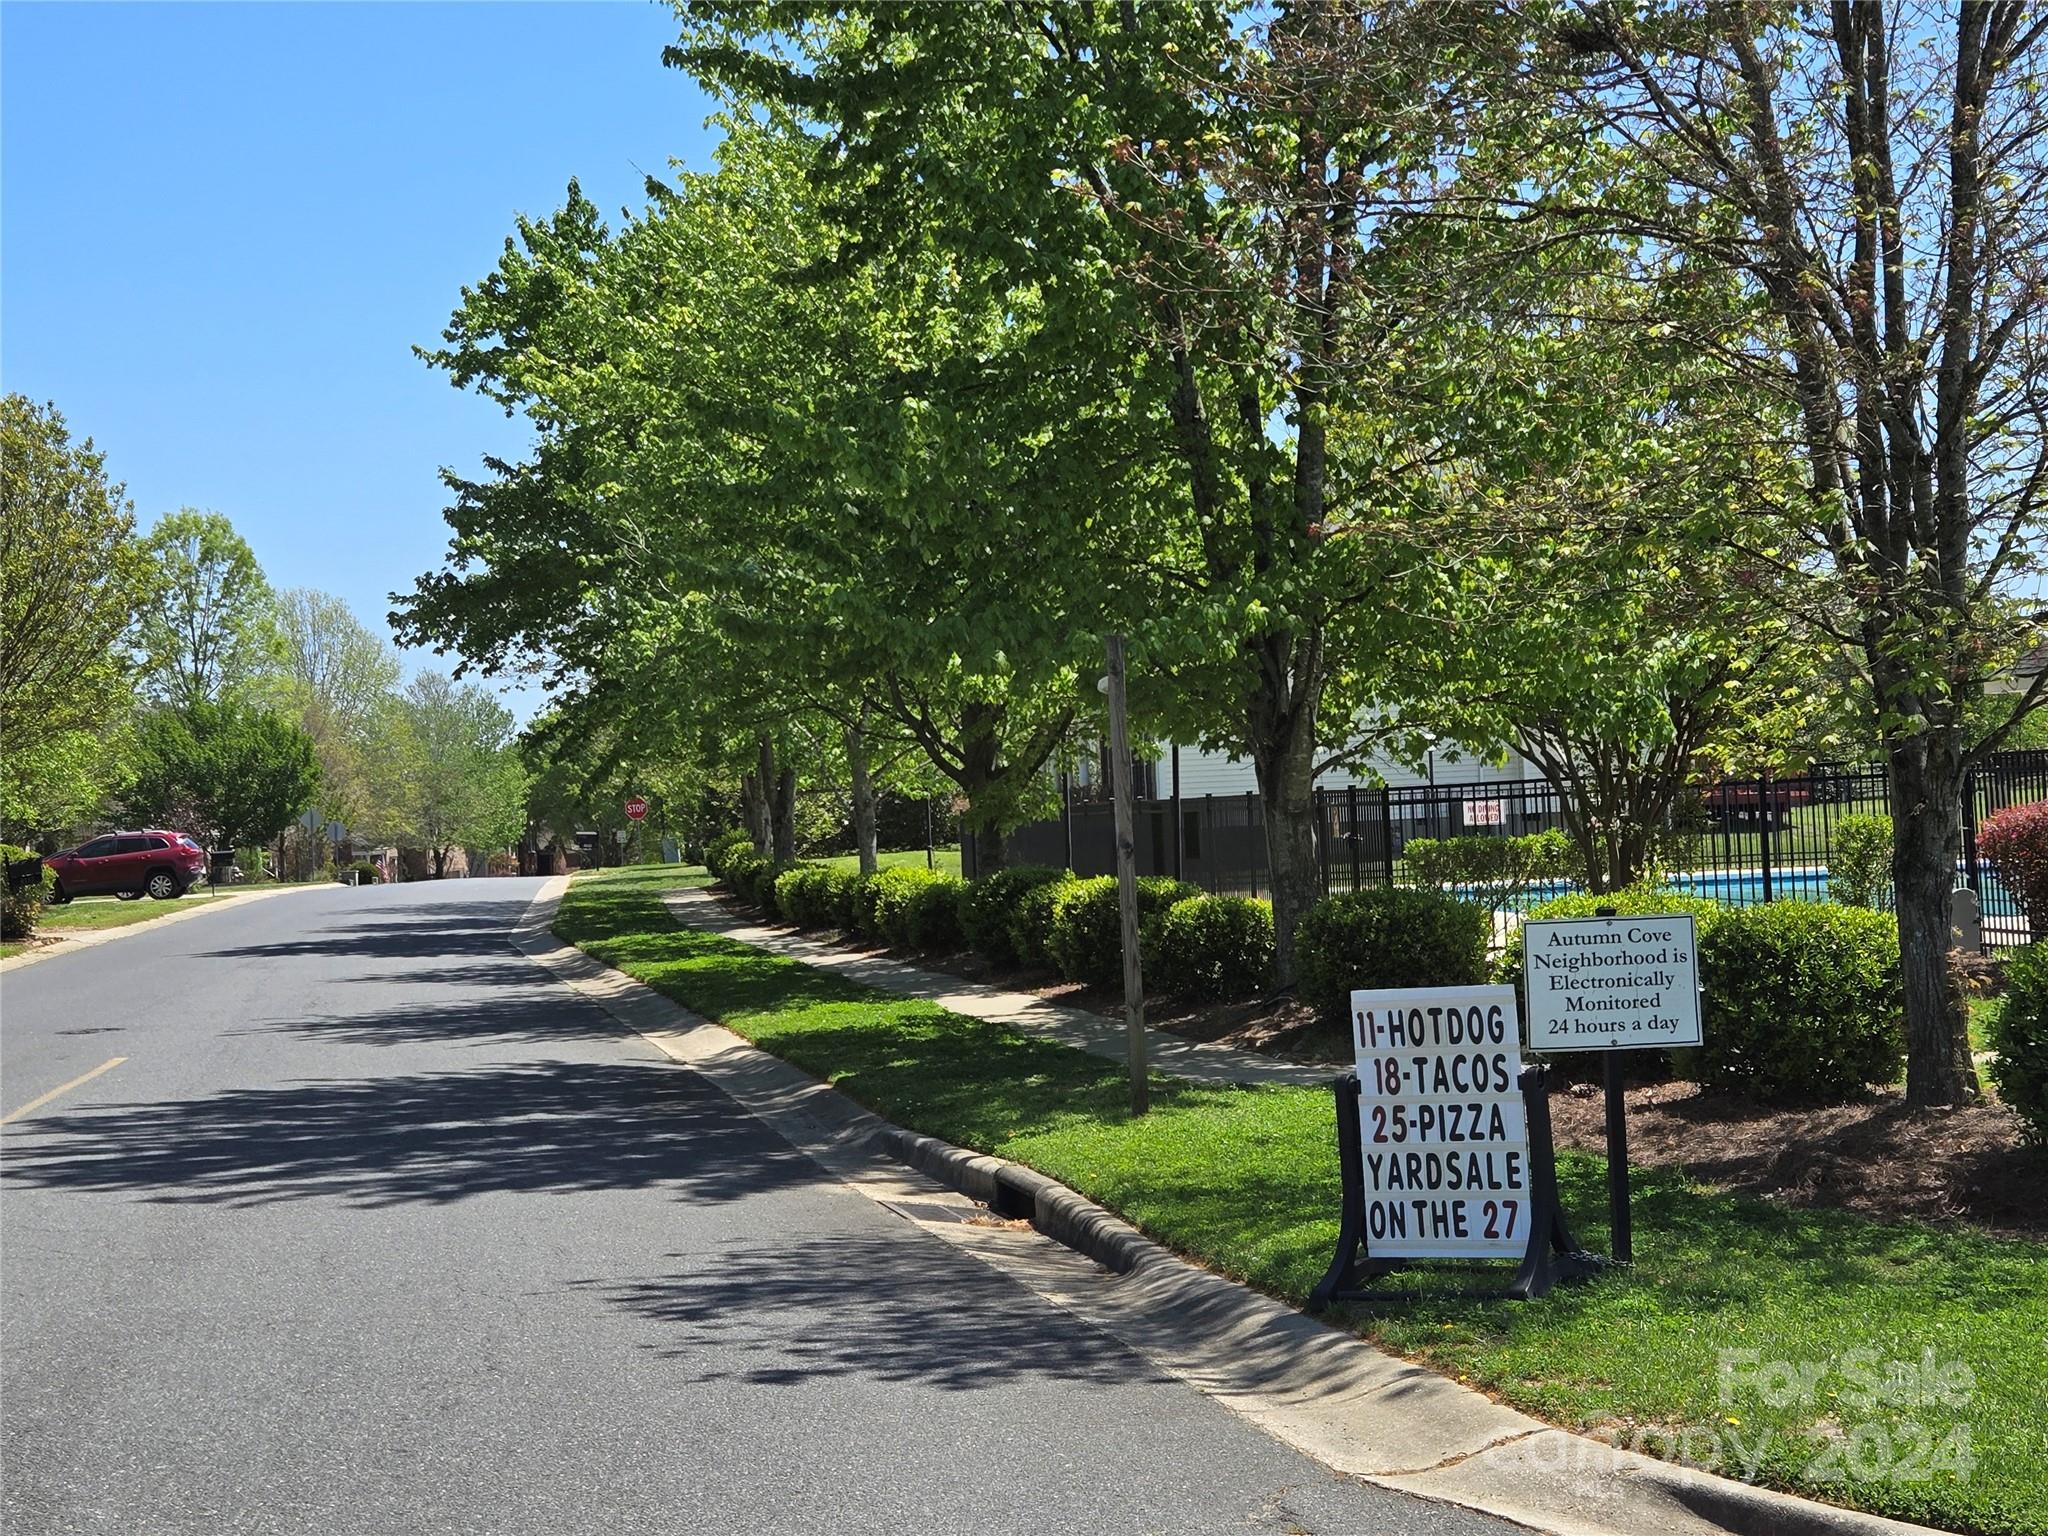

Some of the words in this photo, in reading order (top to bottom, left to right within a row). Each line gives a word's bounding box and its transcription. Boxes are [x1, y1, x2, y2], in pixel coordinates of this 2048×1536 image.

[627, 803, 646, 814] STOP
[1547, 931, 1623, 947] Autumn
[1627, 928, 1673, 944] Cove
[1533, 949, 1668, 973] Neighborhood
[1672, 948, 1688, 964] is
[1549, 971, 1675, 991] Electronically
[1565, 993, 1661, 1012] Monitored
[1357, 1005, 1505, 1048] 11-HOTDOG
[1548, 1018, 1569, 1034] 24
[1575, 1018, 1626, 1034] hours
[1631, 1020, 1642, 1031] a
[1647, 1014, 1680, 1033] day
[1373, 1053, 1509, 1095] 18-TACOS
[1372, 1103, 1506, 1144] 25-PIZZA
[1367, 1151, 1523, 1191] YARDSALE
[1369, 1200, 1407, 1240] ON
[1411, 1200, 1469, 1240] THE
[1483, 1200, 1519, 1239] 27
